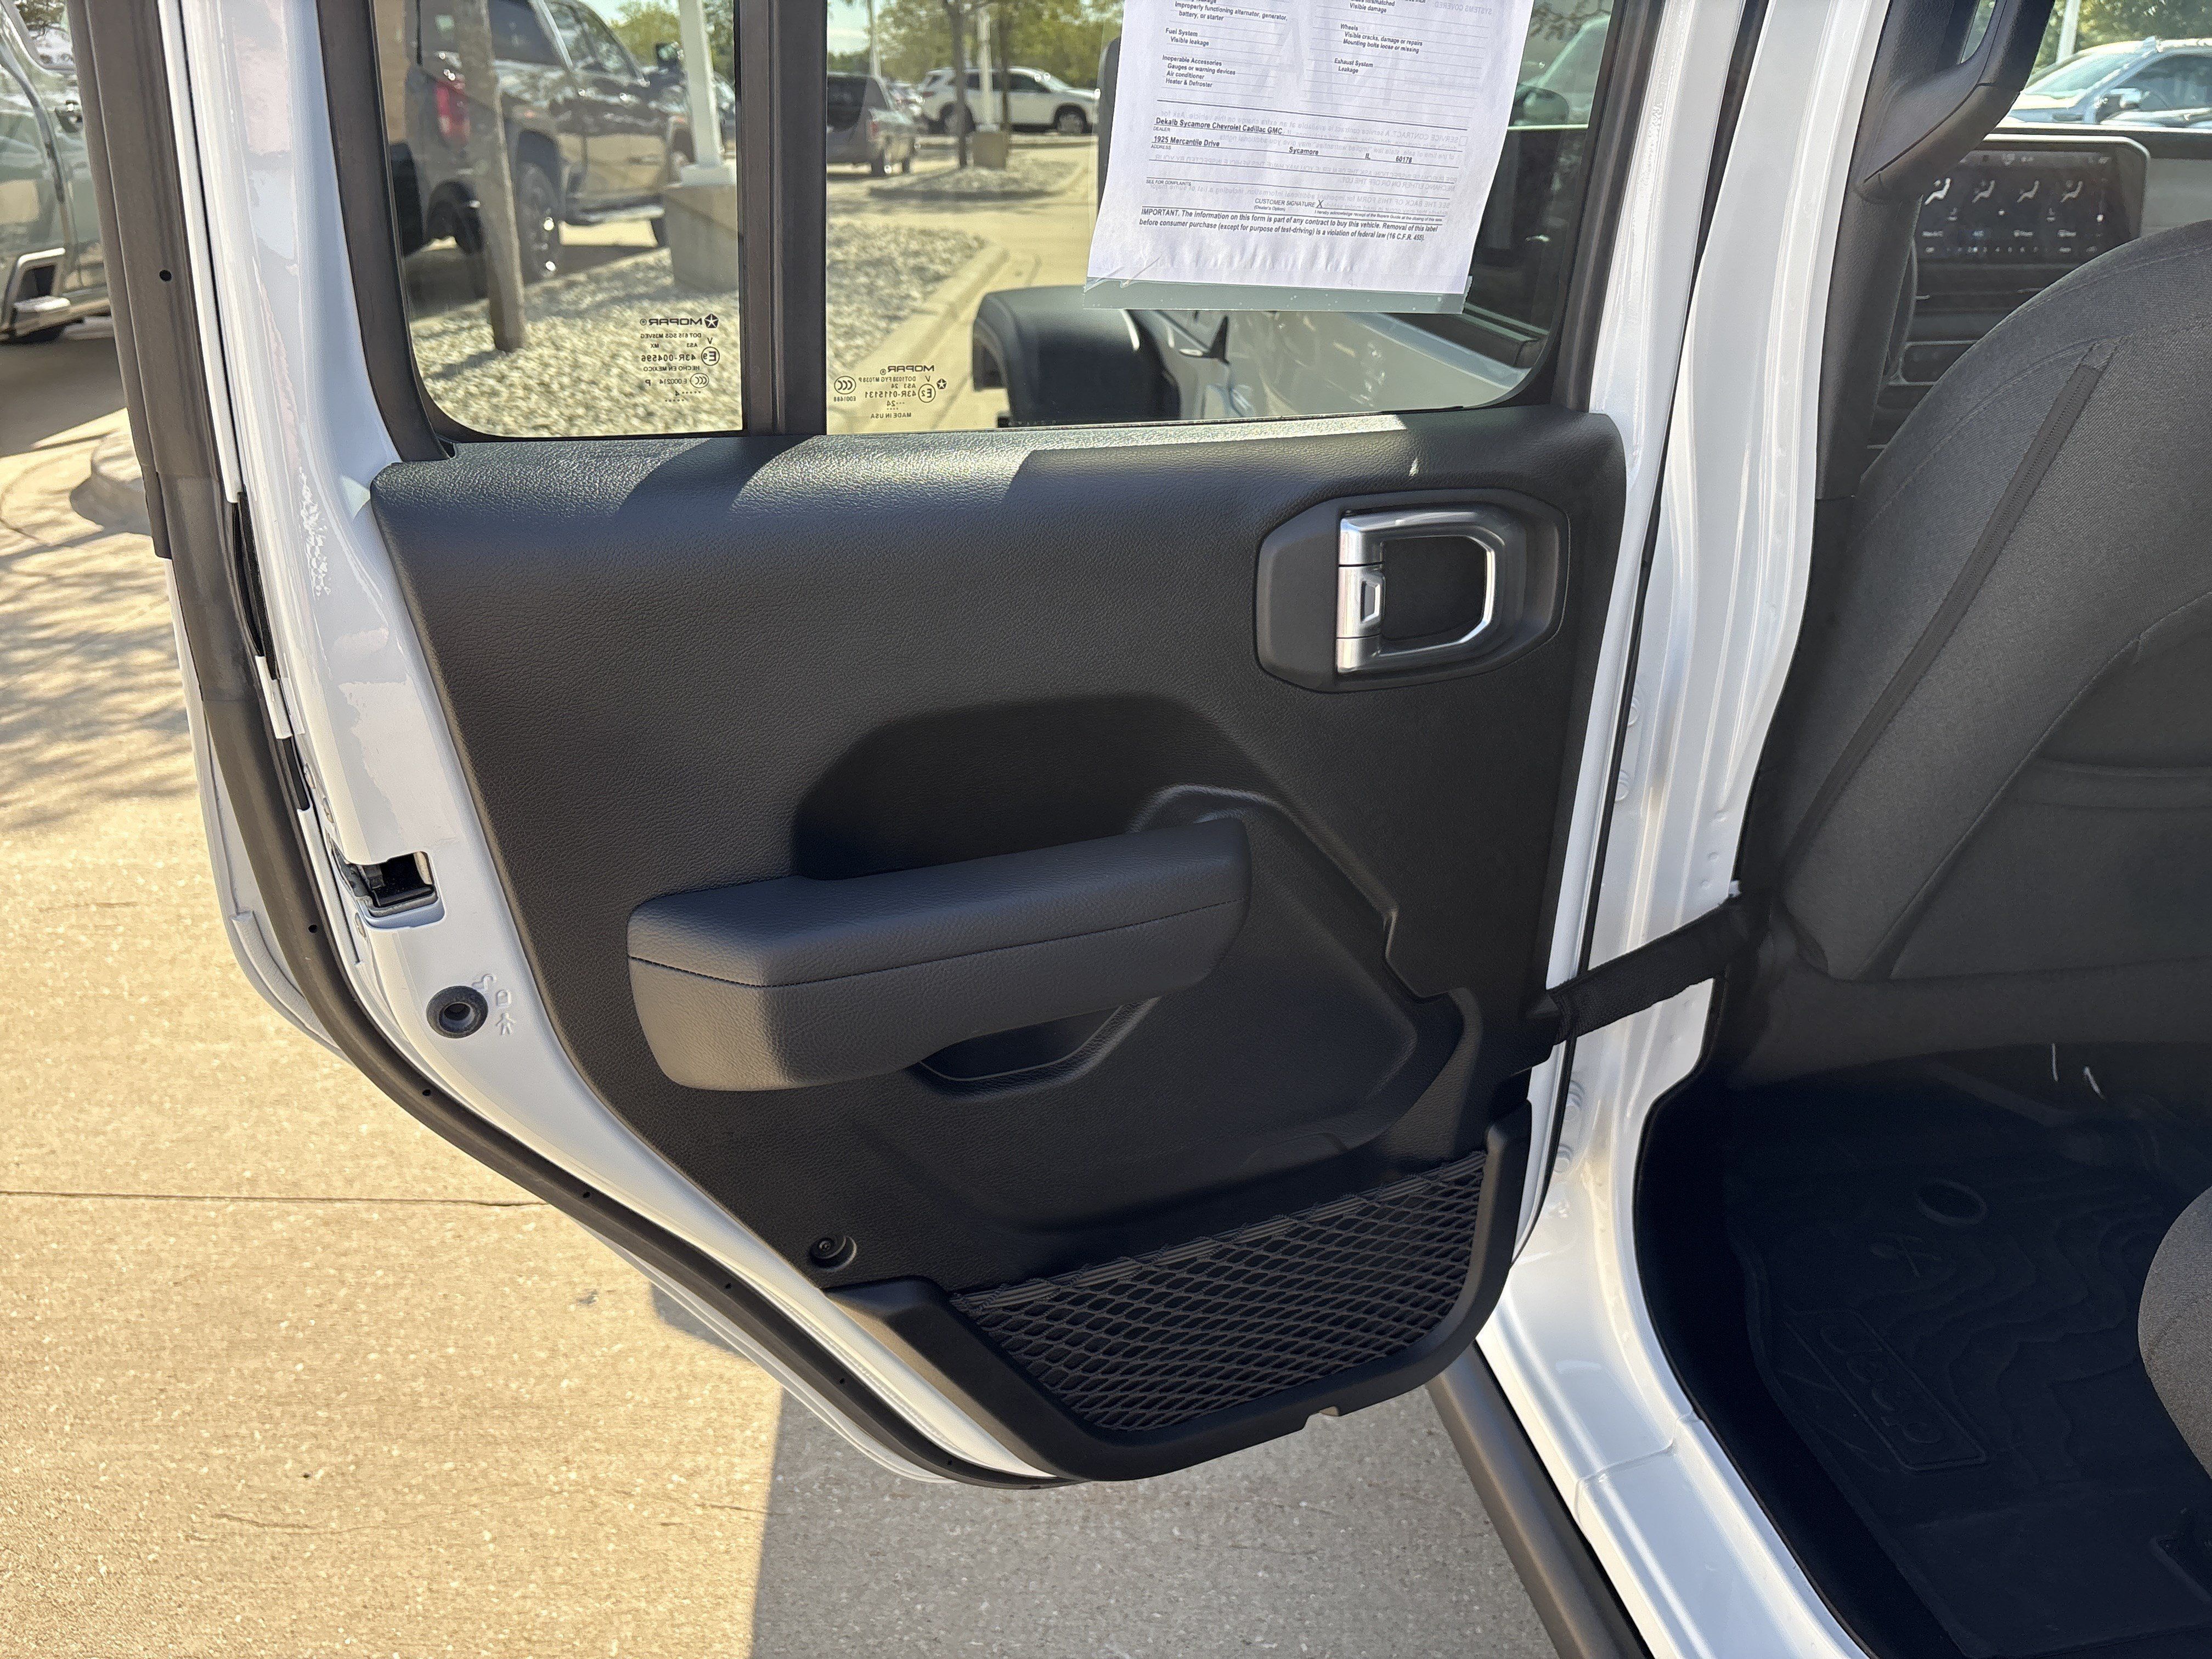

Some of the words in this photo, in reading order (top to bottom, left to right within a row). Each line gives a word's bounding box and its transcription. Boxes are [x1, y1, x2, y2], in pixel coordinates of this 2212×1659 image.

[1175, 1, 1203, 11] Improperly
[1205, 5, 1233, 15] functioning
[1234, 9, 1260, 18] alternator,
[1262, 13, 1287, 21] generator,
[1178, 10, 1198, 19] battery,
[1367, 5, 1386, 14] damage
[1162, 55, 1189, 64] Inoperable
[1190, 58, 1222, 66] Accessories
[1189, 80, 1212, 88] Defroster
[1155, 117, 1178, 126] Dekalb
[1179, 119, 1210, 128] Sycamore
[1212, 122, 1241, 131] Chevrolet
[1242, 124, 1266, 133] Cadillac
[1170, 137, 1202, 146] Mercantile
[1289, 146, 1318, 155] Sycamore
[1194, 211, 1229, 220] information
[1337, 219, 1346, 228] buy
[1361, 221, 1380, 229] vehicle.
[1382, 222, 1406, 230] Removal
[1217, 222, 1239, 232] (except
[1281, 226, 1315, 236] test-driving)
[1386, 232, 1395, 240] (16
